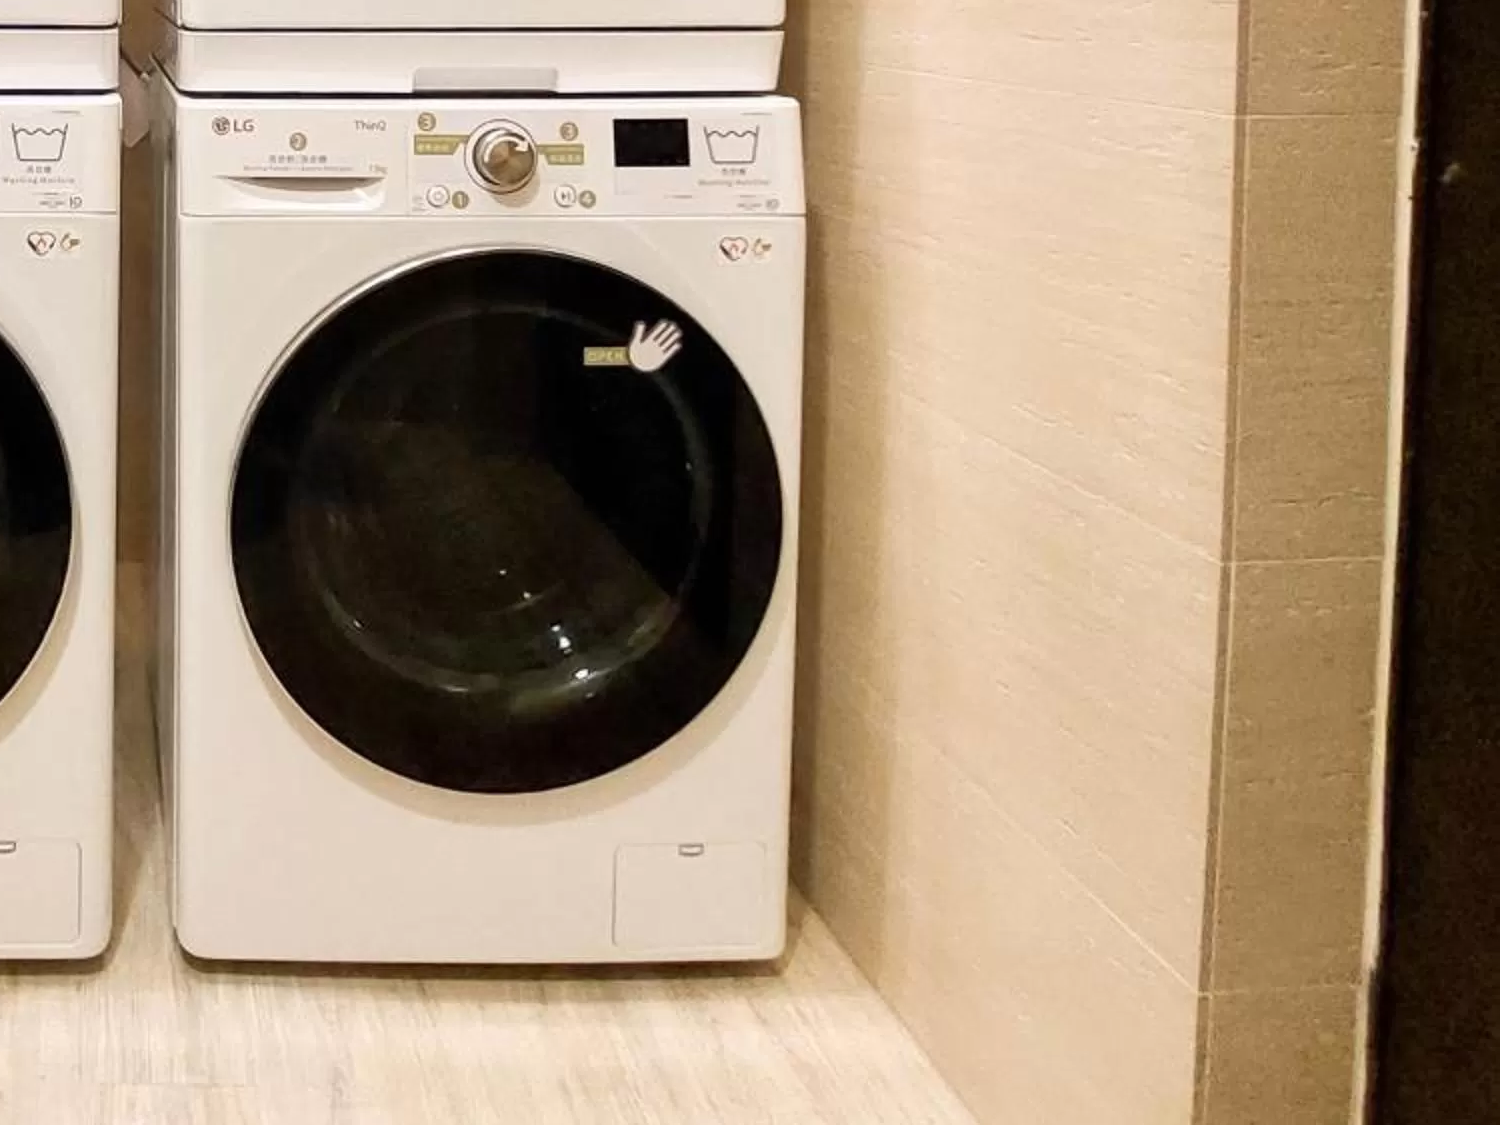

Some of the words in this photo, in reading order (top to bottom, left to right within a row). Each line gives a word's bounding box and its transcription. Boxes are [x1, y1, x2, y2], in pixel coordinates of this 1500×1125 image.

[233, 119, 255, 132] LG
[355, 120, 388, 132] ThinQ
[588, 350, 624, 363] OPEN
